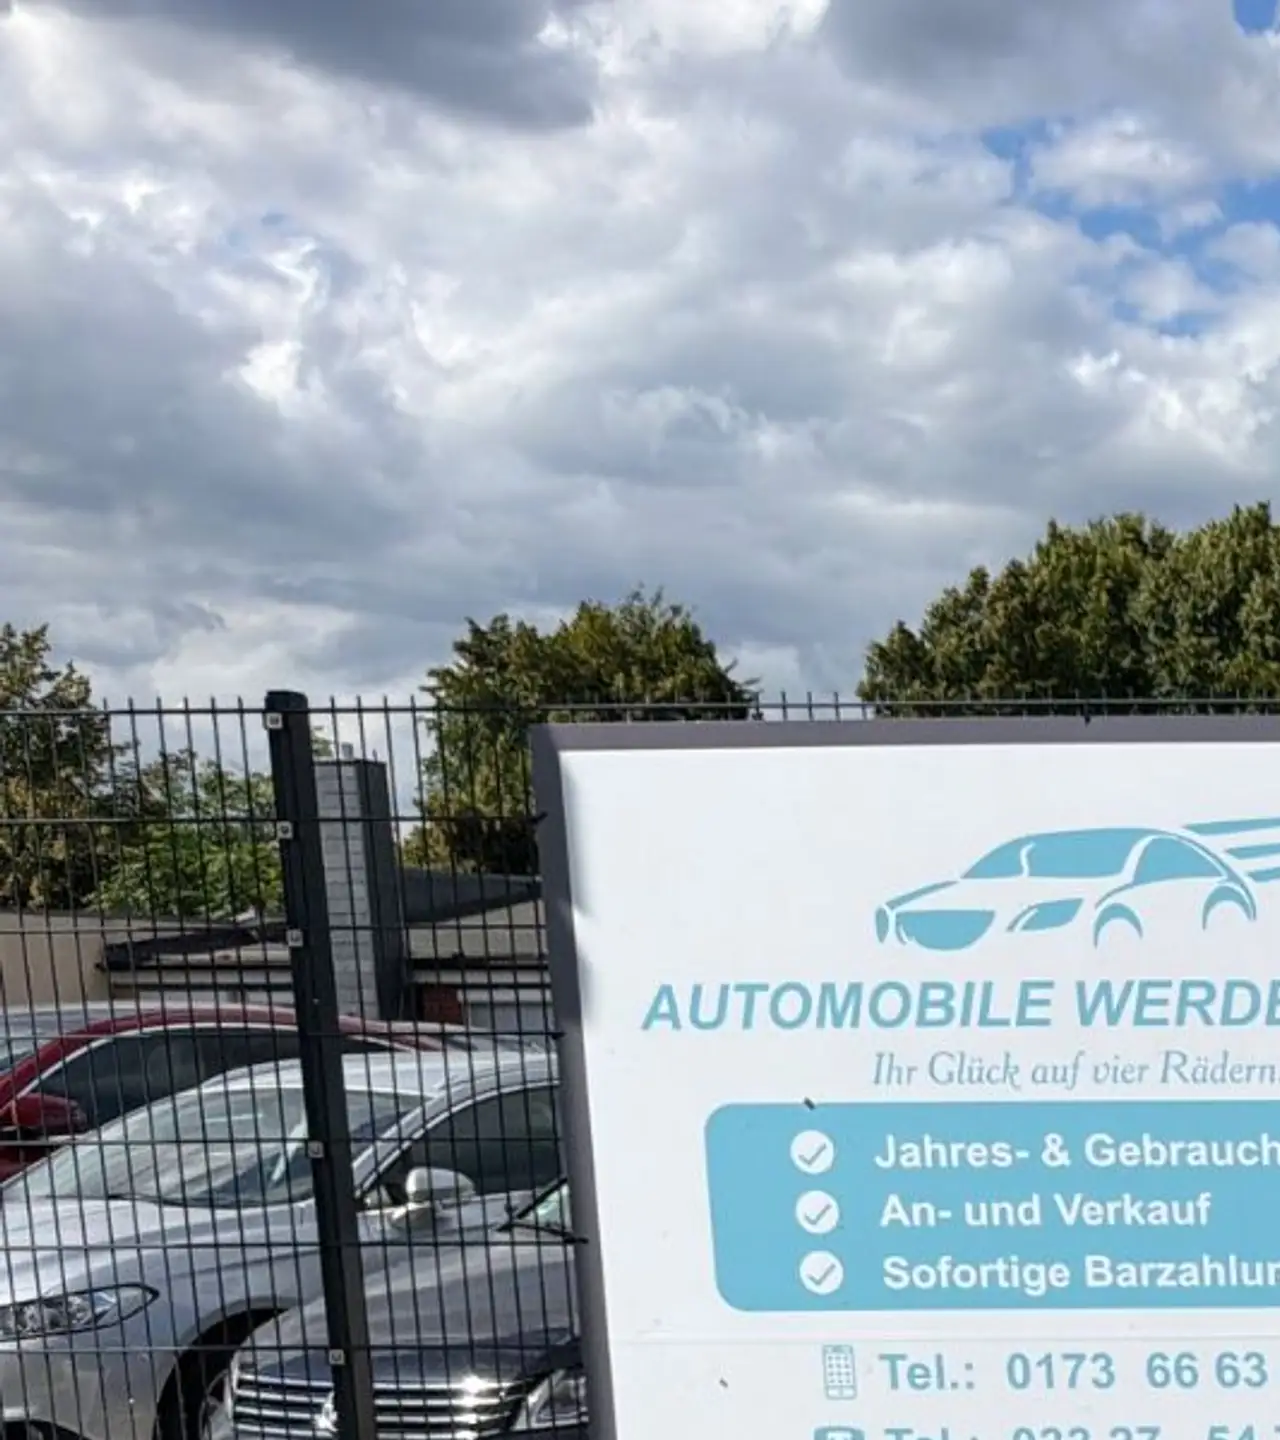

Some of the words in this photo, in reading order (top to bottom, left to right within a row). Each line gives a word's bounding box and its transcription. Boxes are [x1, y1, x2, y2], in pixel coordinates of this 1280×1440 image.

[641, 979, 1056, 1031] AUTOMOBILE
[873, 1052, 918, 1086] Ihr
[928, 1051, 1021, 1089] Glück
[1031, 1051, 1087, 1090] auf
[1093, 1055, 1150, 1085] vier
[875, 1135, 1029, 1168] Jahres-
[1041, 1133, 1070, 1166] &
[881, 1194, 952, 1226] An-
[965, 1194, 1041, 1226] und
[1054, 1192, 1212, 1225] Verkauf
[884, 1255, 1070, 1296] Sofortige
[878, 1353, 975, 1391] Tel.:
[1006, 1351, 1116, 1390] 0173
[1146, 1351, 1200, 1389] 66
[1214, 1351, 1269, 1389] 63
